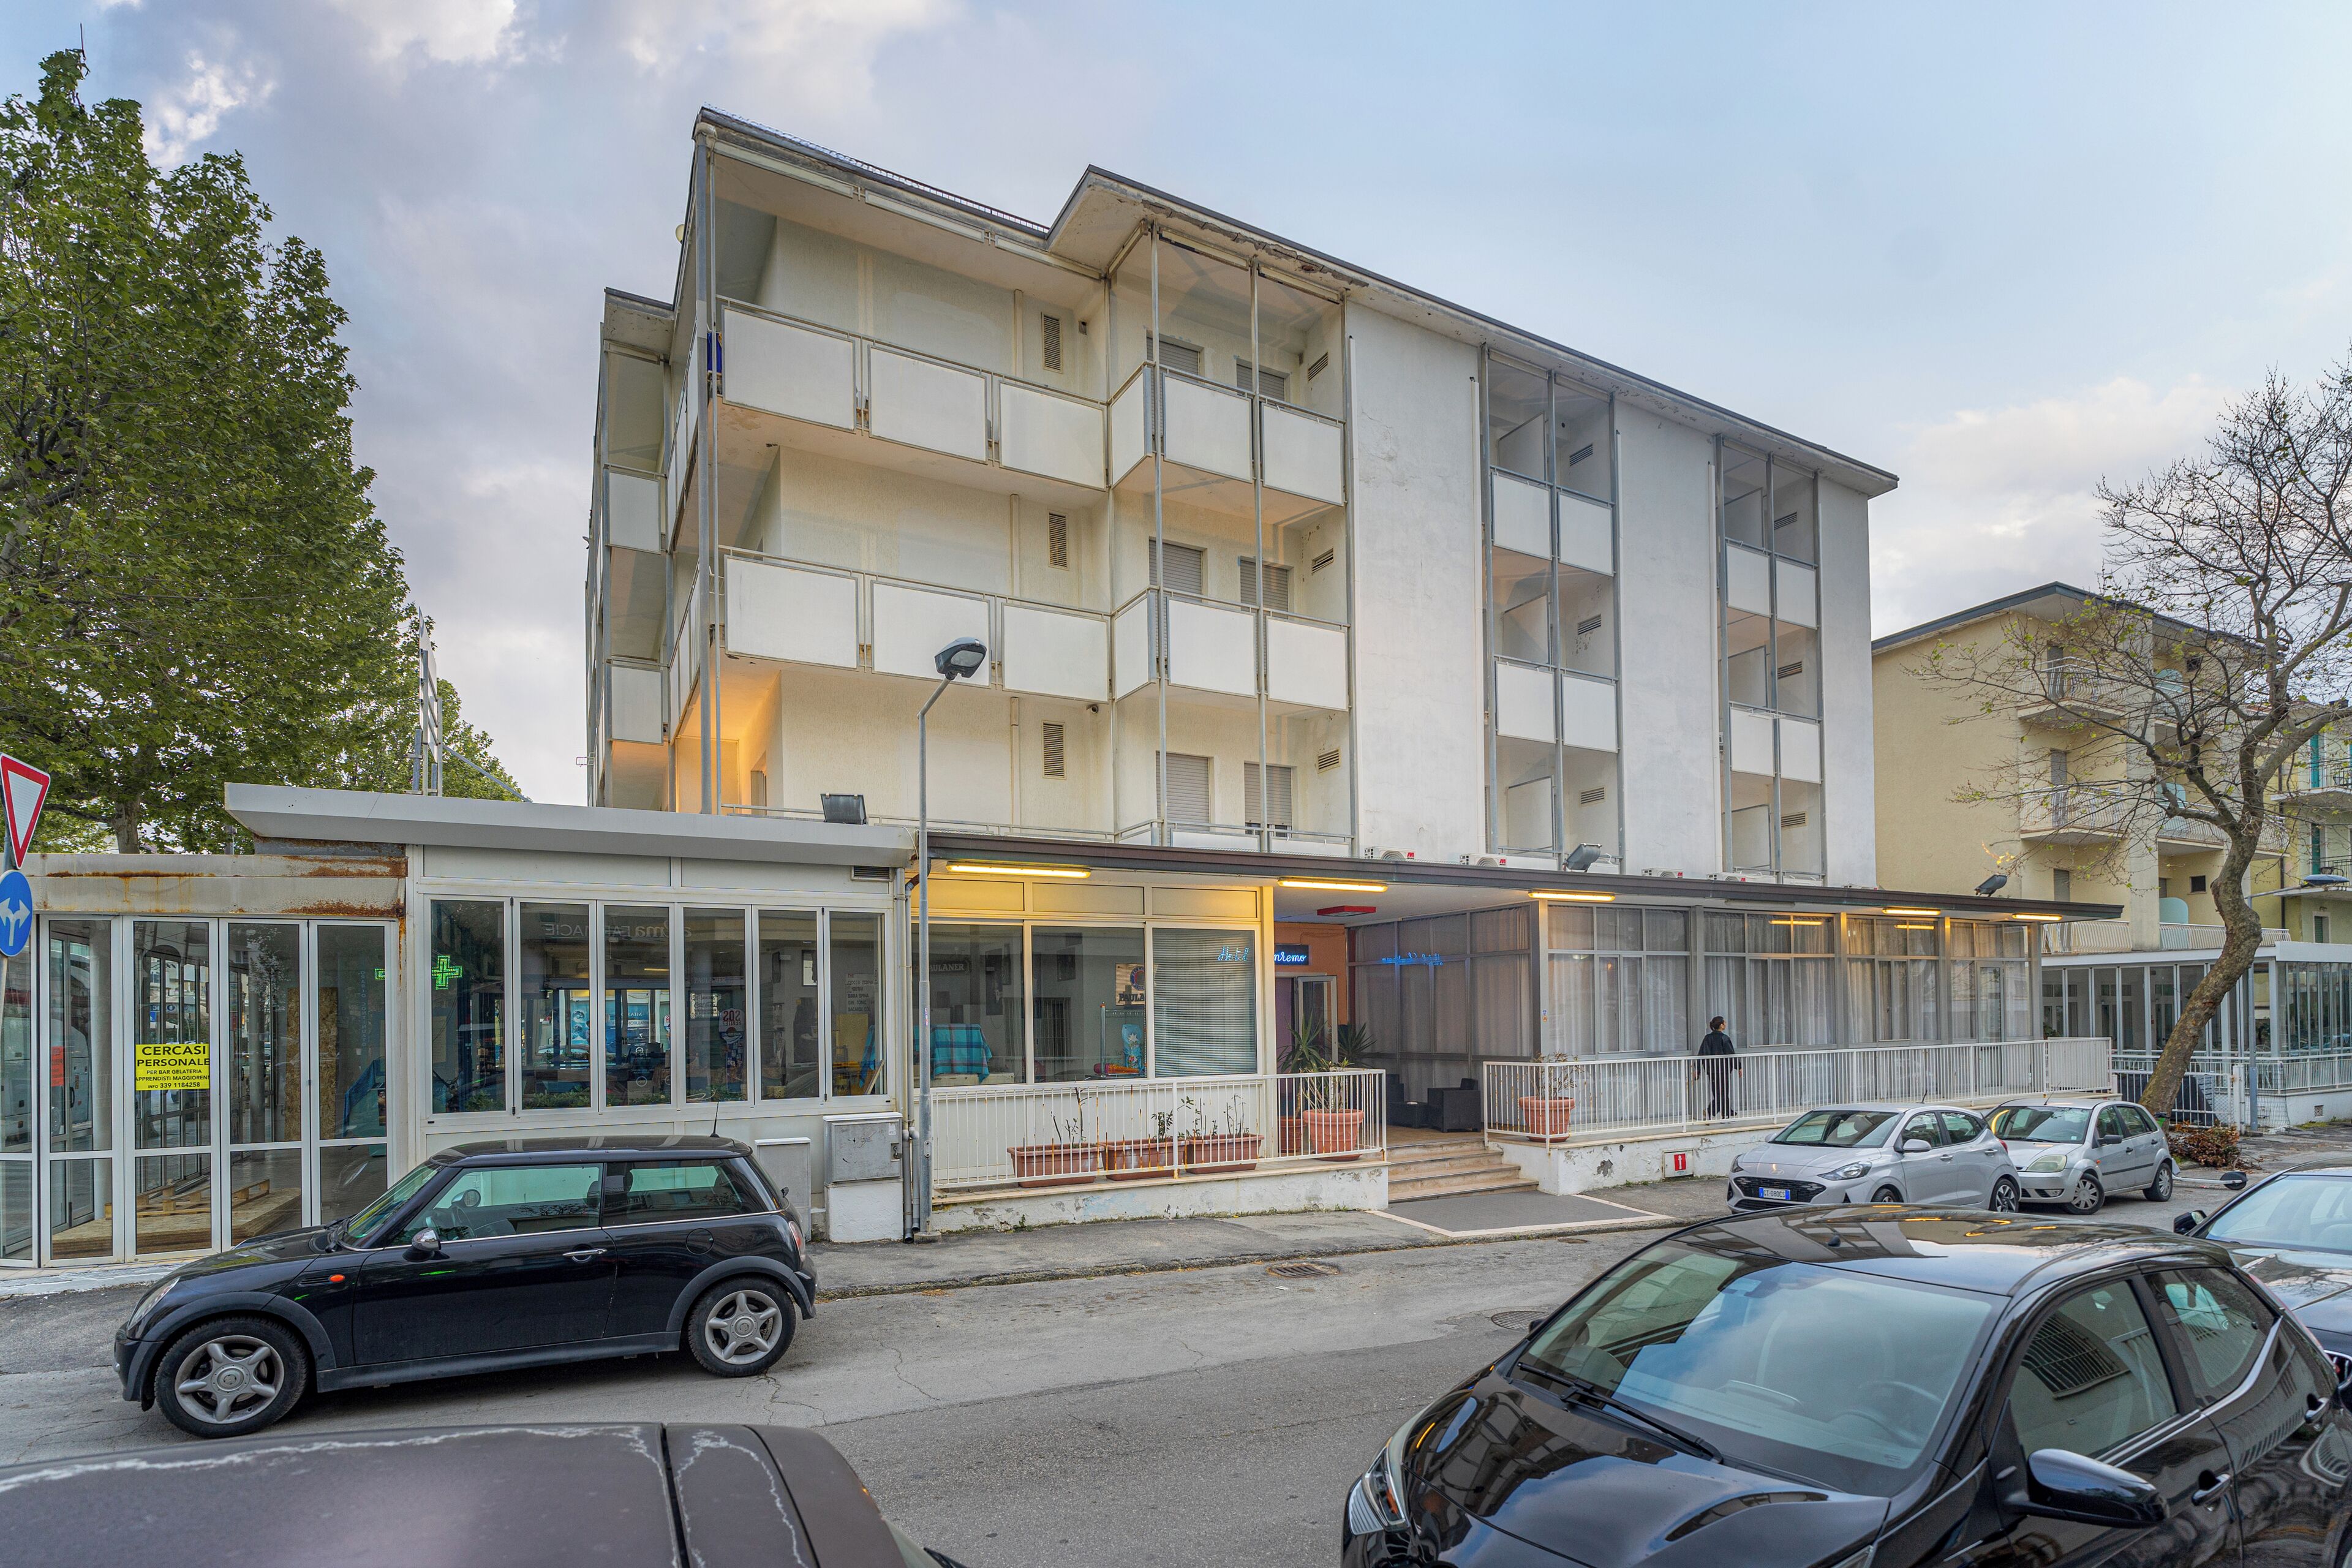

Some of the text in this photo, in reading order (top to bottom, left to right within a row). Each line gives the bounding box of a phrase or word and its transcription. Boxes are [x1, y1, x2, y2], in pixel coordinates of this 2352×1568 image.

[1274, 951, 1307, 962] nremo
[929, 963, 965, 971] AULANER
[1118, 993, 1145, 1003] PAULA
[142, 1046, 206, 1055] CERCASI
